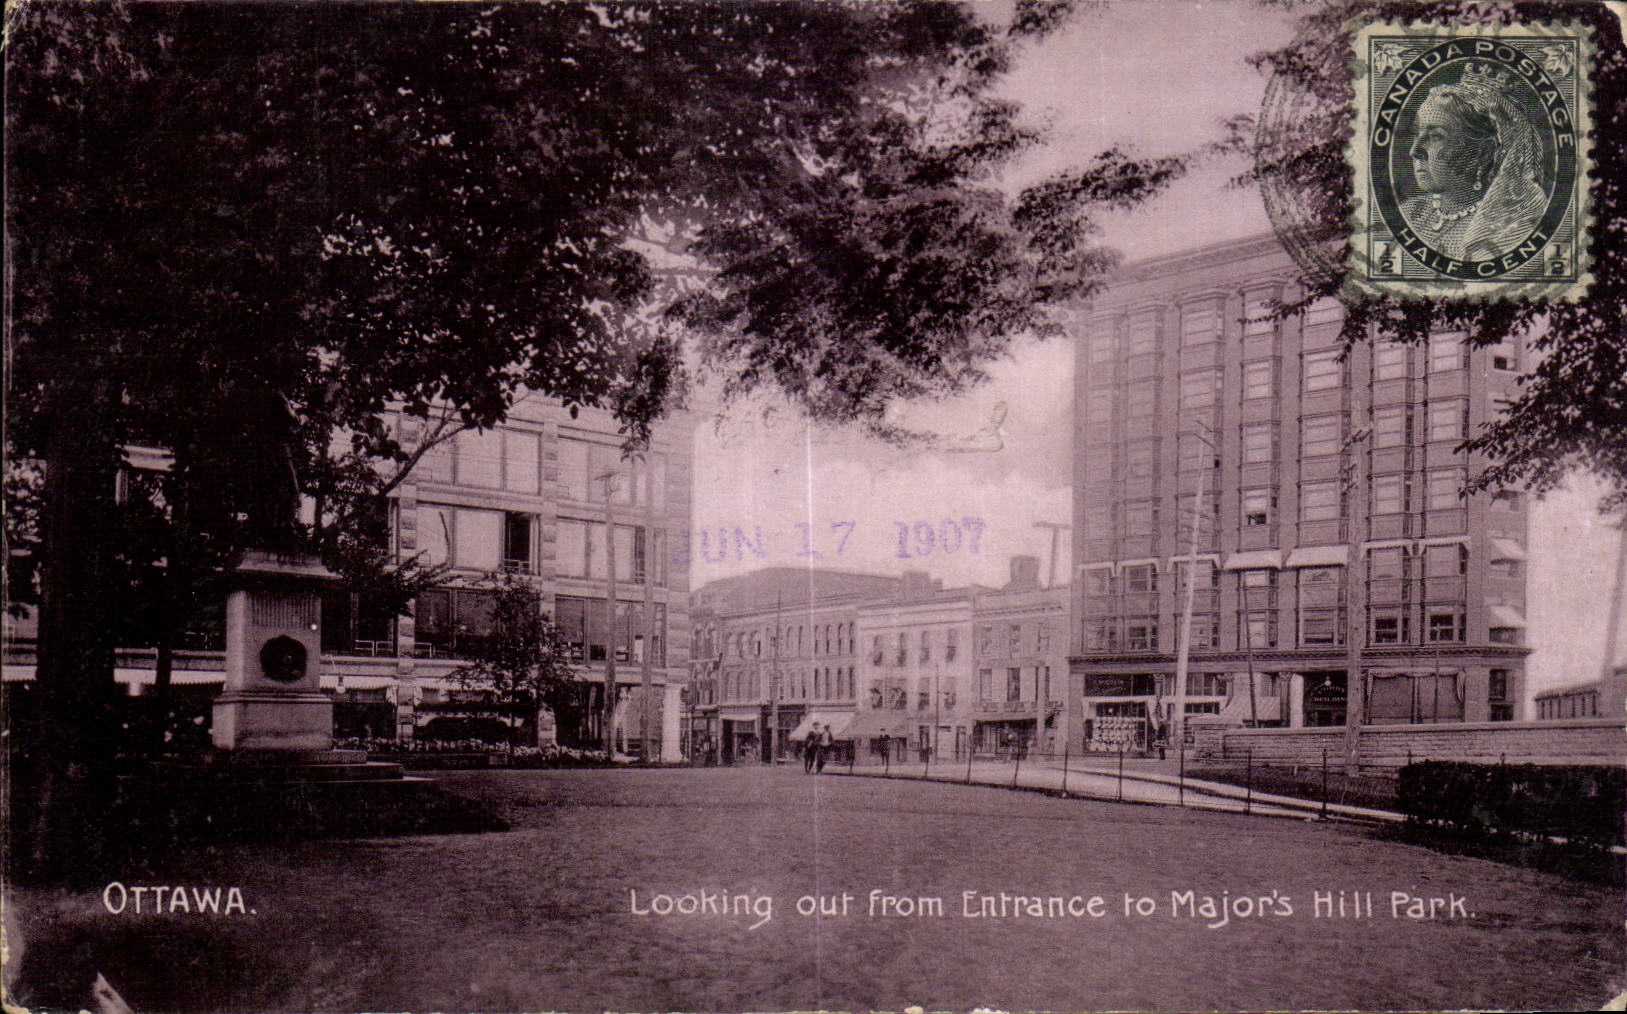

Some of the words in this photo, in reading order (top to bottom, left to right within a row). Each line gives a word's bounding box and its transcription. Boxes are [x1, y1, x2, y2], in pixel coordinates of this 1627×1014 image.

[1374, 41, 1464, 148] CANADA
[1475, 40, 1574, 149] POSTAGE
[1398, 227, 1463, 273] HALF
[1476, 225, 1549, 277] CENT
